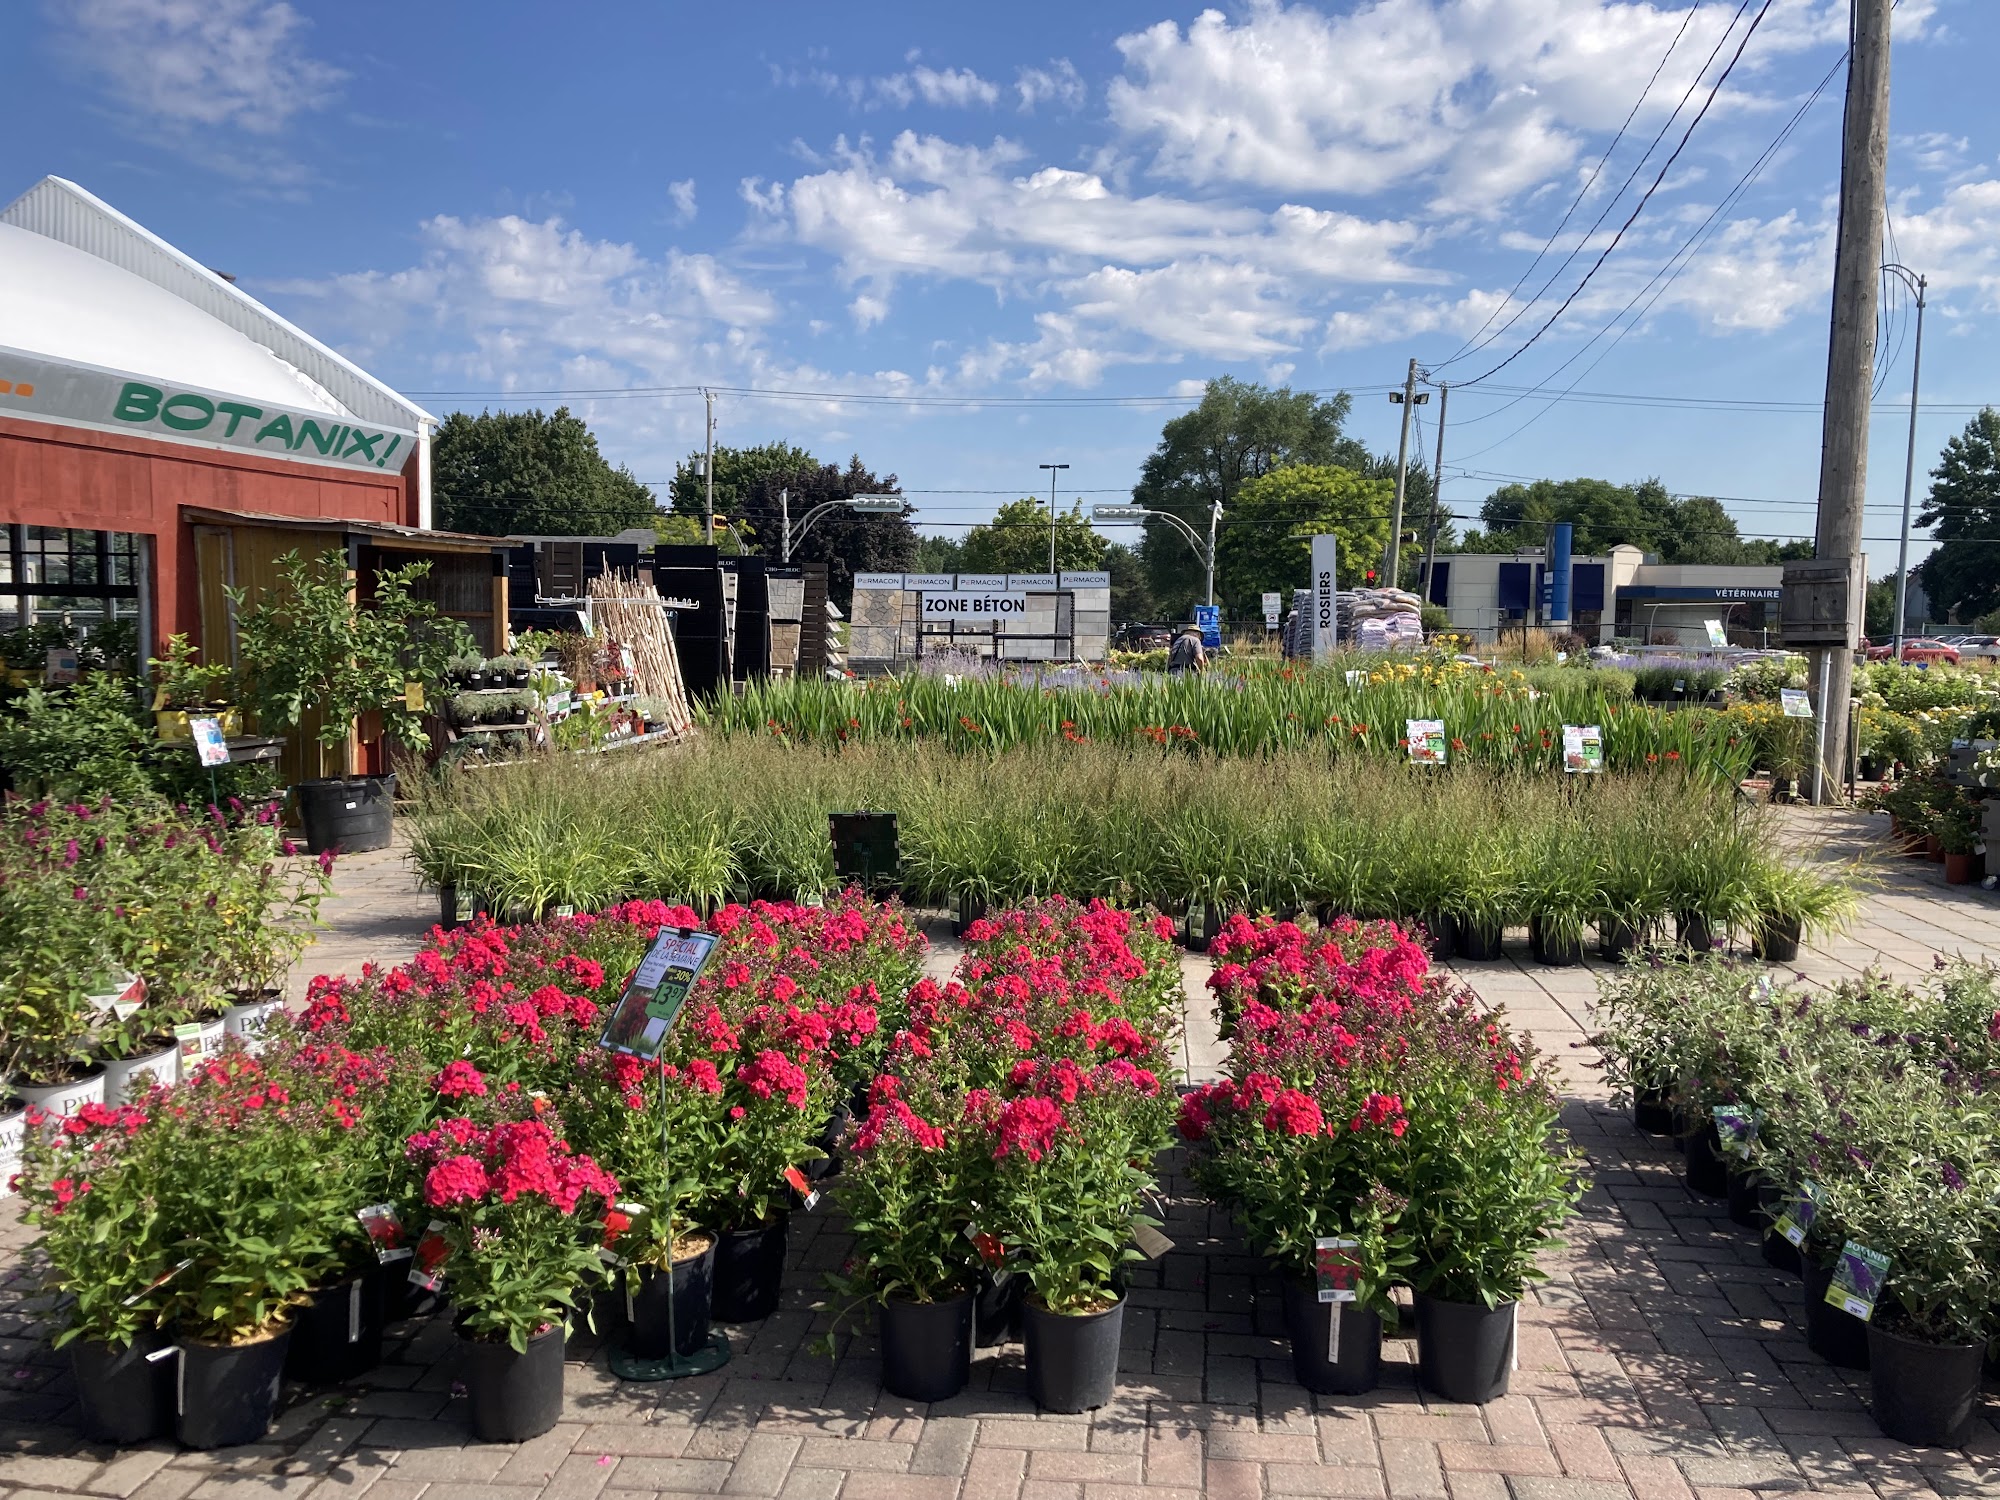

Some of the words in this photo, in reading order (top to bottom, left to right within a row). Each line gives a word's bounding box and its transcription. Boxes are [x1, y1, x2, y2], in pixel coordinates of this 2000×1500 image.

[112, 382, 401, 468] BOTANIX!
[857, 577, 900, 585] PERMACON
[1319, 571, 1331, 629] ROSIERS
[1715, 588, 1780, 598] VÉTÉRINAIRE
[925, 598, 968, 613] ZONE
[973, 594, 1026, 613] BÉTON
[674, 969, 692, 982] 30%
